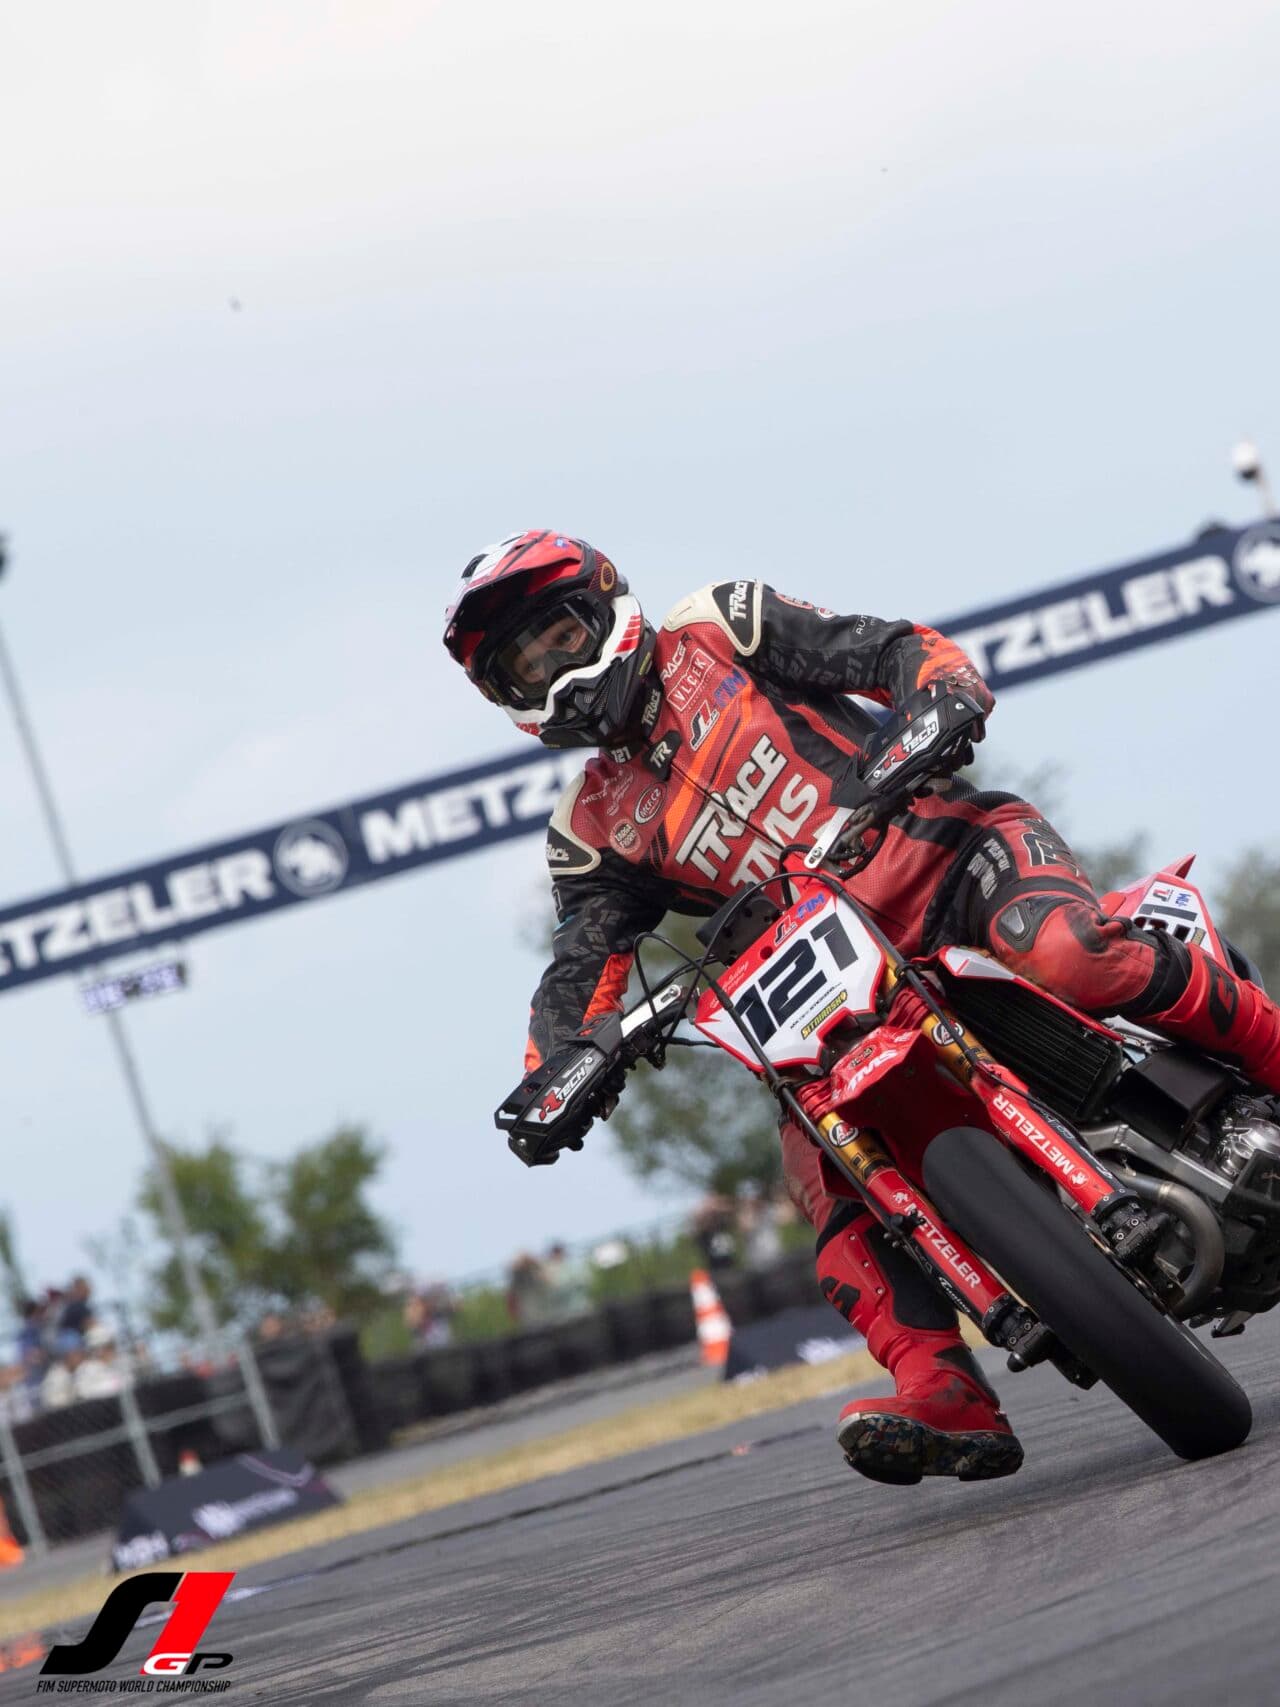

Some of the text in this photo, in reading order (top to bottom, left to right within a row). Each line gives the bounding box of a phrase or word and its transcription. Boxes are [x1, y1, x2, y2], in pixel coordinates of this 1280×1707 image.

[961, 554, 1234, 681] TZELER
[360, 750, 592, 864] METZ
[0, 847, 276, 977] TZELER
[796, 892, 825, 920] FIM
[733, 911, 859, 1048] 121
[992, 1093, 1075, 1183] METZELER
